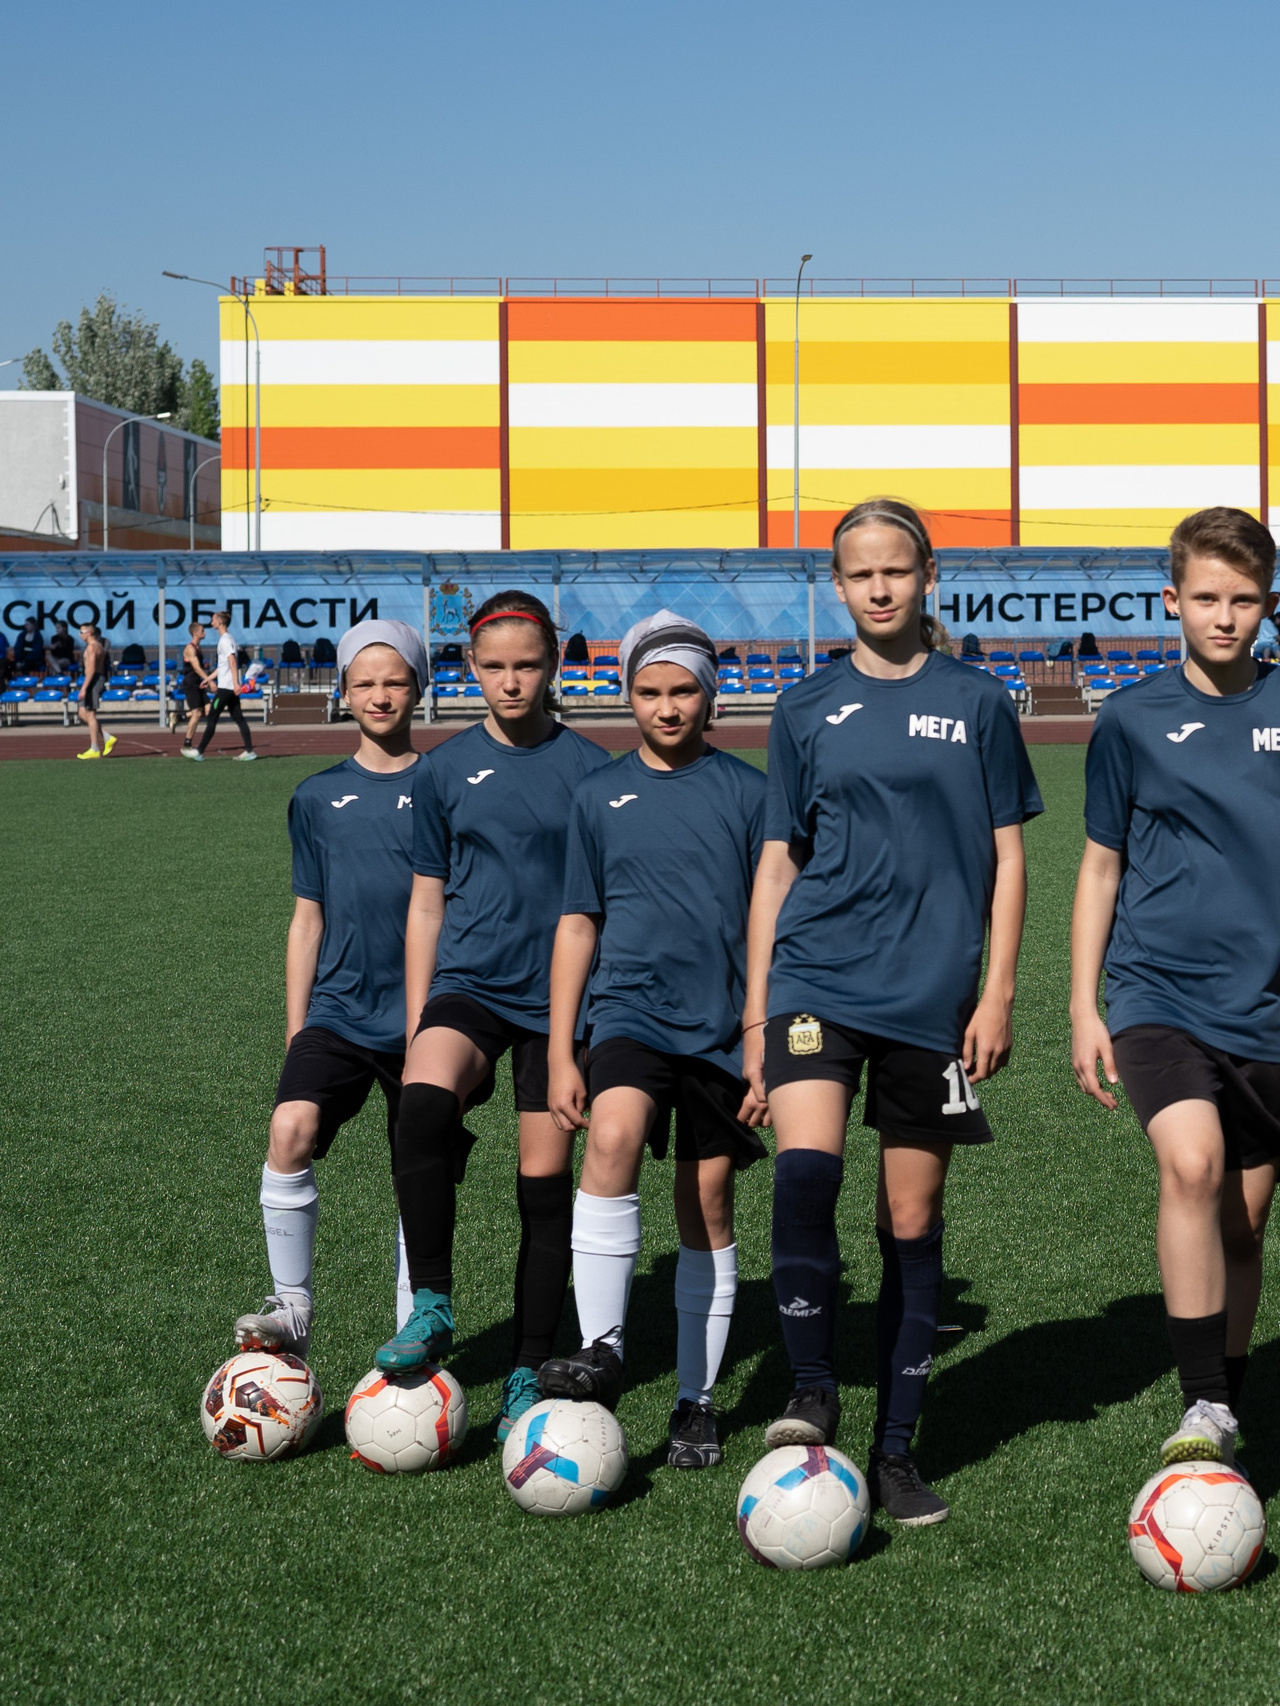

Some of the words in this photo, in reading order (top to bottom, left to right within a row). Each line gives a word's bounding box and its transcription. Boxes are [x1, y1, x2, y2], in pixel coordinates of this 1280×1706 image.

[3, 591, 135, 630] СКОЙ
[153, 598, 378, 629] ОБЛАСТИ
[922, 592, 1180, 622] НИСТЕРСТ
[909, 714, 967, 744] МЕГА
[779, 1304, 822, 1317] DEMIX
[1208, 1510, 1235, 1551] KIPSTA
